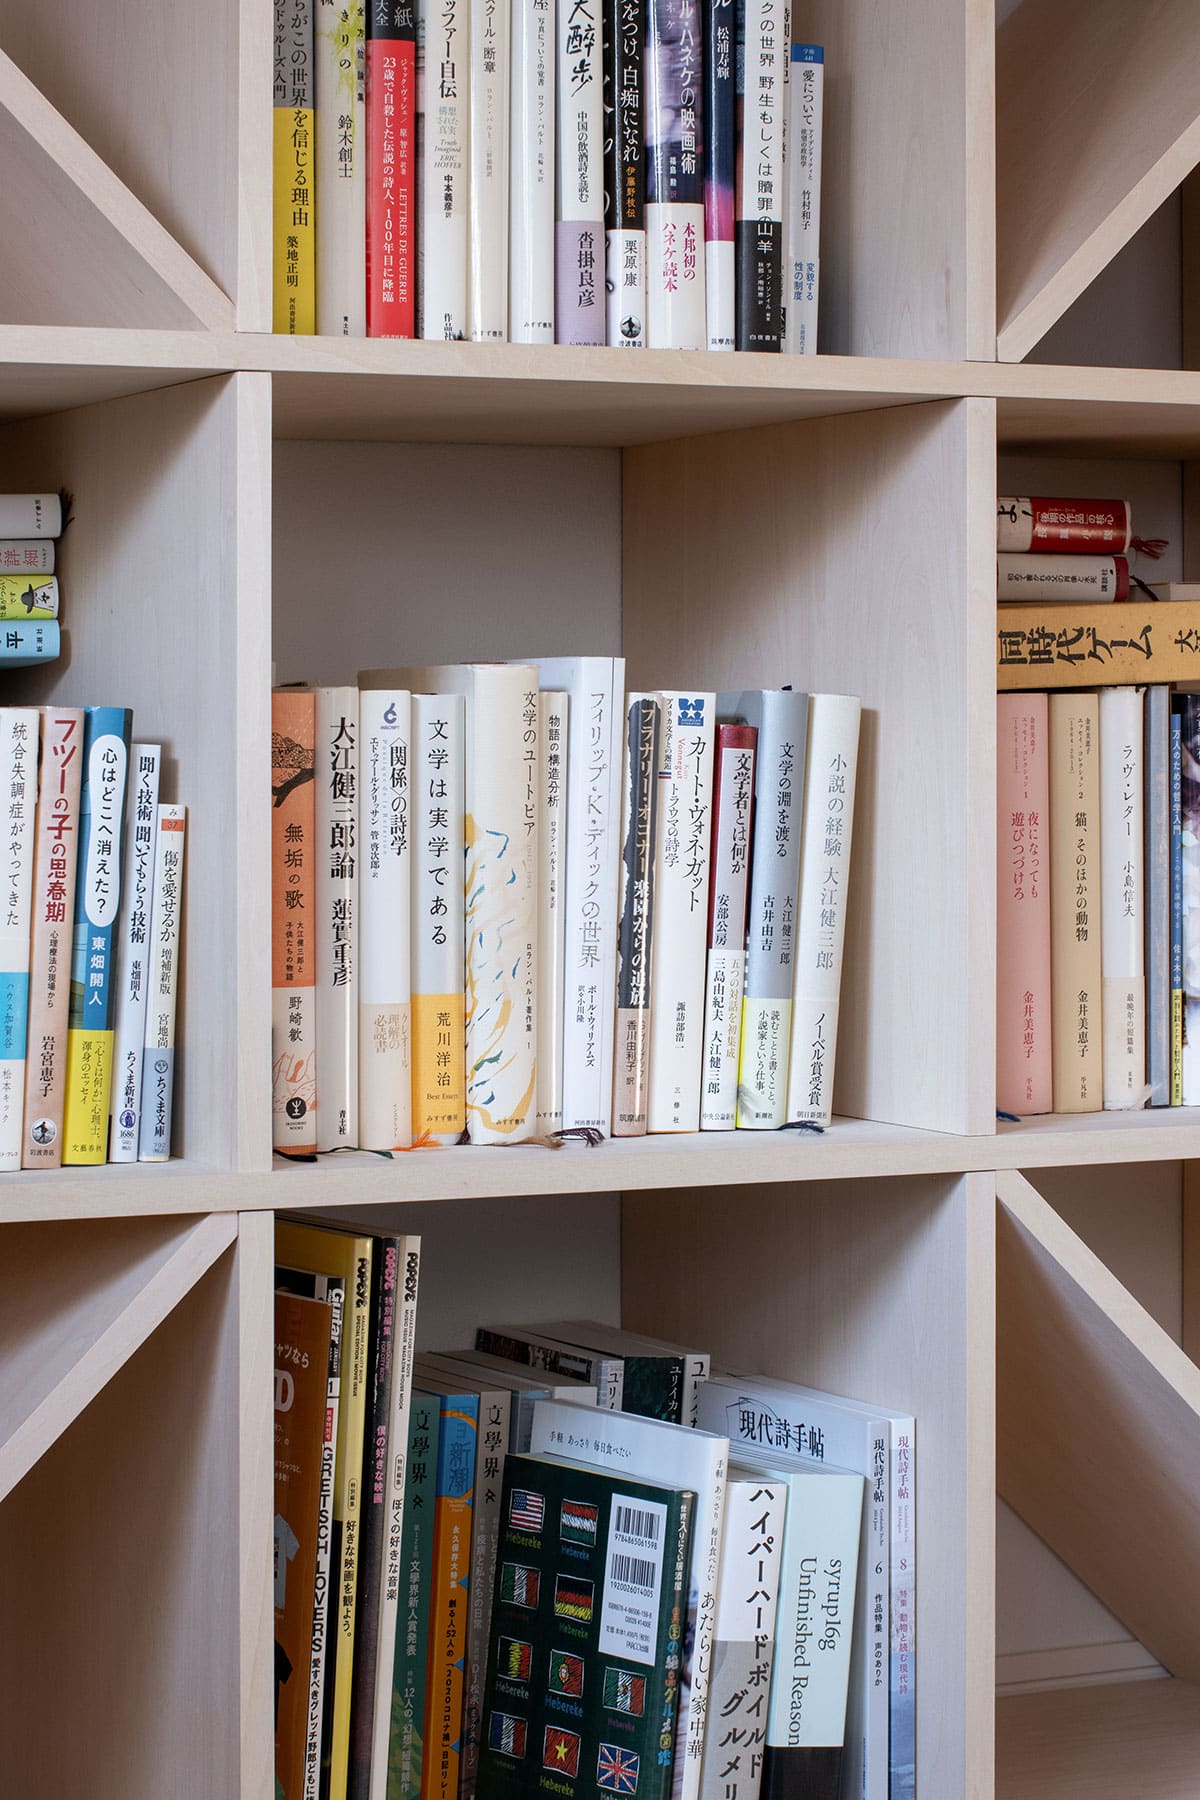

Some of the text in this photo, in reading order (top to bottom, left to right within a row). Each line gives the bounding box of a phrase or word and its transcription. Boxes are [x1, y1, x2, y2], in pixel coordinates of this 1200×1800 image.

[375, 0, 389, 26] 大全
[393, 7, 412, 29] 紙
[759, 1, 775, 68] クの世界
[620, 0, 640, 162] をつけ、白痴になれ
[680, 0, 696, 175] ル・ハネケの映画術
[717, 26, 731, 80] 松浦寿輝
[802, 69, 815, 125] 愛について
[337, 115, 353, 179] 鈴木創士
[382, 56, 397, 303] 23歳で自殺した伝説の詩人、100年目に降臨
[801, 189, 811, 231] 竹村和子
[286, 236, 298, 287] 築地正明
[399, 187, 408, 304] LETTRES DE GUERRE
[577, 231, 595, 308] 沓掛良彦
[624, 240, 638, 287] 栗原康
[663, 222, 678, 293] ハネケ読本
[683, 222, 696, 281] 本邦初の
[794, 261, 804, 301] 性の制度
[6, 631, 24, 649] 平
[998, 624, 1153, 666] 同時代ゲーム
[369, 737, 380, 826] エドゥアール・グリッサン
[522, 691, 537, 836] 文学のユートピア
[547, 714, 561, 808] 物語の構造分析
[635, 709, 655, 873] フラナリー・オコナー
[7, 722, 28, 926] 統合失調症がやってきた
[44, 720, 77, 923] フツーの子の思春期
[329, 717, 356, 880] 大江健三郎論
[389, 737, 409, 857] 〈関係〉の詩学
[427, 719, 449, 945] 文学は実学である
[577, 693, 608, 969] フィリップ・K・ディックの世界
[663, 783, 680, 868] トラウマの詩学
[682, 736, 709, 912] カート・ヴォネガット
[730, 753, 752, 875] 文学者とは何か
[775, 742, 795, 857] 文学の淵を渡る
[1122, 745, 1136, 918] ラヴ・レター 小島信夫
[131, 756, 155, 944] 聞く技術 聞いてもらう技術
[284, 823, 305, 910] 無垢の歌
[815, 753, 848, 970] 小説の経験 大江健三郎
[1010, 811, 1025, 901] 遊びつづけろ
[1028, 811, 1040, 899] 夜になっても
[1075, 811, 1088, 942] 猫、そのほかの動物
[160, 850, 179, 995] 傷を愛せるか 増補新版
[285, 921, 294, 981] 子供たちの物語
[296, 921, 305, 973] 大江健三郎と
[715, 893, 730, 946] 安部公房
[760, 895, 776, 951] 古井由吉
[779, 895, 793, 965] 大江健三郎
[88, 936, 107, 1006] 東畑開人
[130, 961, 142, 1002] 東畑開人
[288, 996, 304, 1043] 野崎歓
[436, 1011, 451, 1087] 荒川洋治
[585, 984, 597, 1068] ポール・ウィリアムズ
[625, 1020, 637, 1073] 香川由利子
[675, 1001, 687, 1049] 諏訪部浩一
[707, 957, 727, 1095] 三島由紀夫 大江健三郎
[754, 1009, 769, 1095] 小説家という仕事。
[1023, 990, 1035, 1058] 金井美恵子
[1077, 989, 1089, 1058] 金井美恵子
[39, 1035, 56, 1098] 岩宮恵子
[80, 1041, 93, 1105] 渾身のエッセイ
[125, 1050, 136, 1109] ちくま新書
[767, 1010, 781, 1106] 読むことと書くこと。
[808, 1012, 826, 1107] ノーベル賞受賞
[154, 1076, 167, 1138] ちくま文庫
[355, 1257, 369, 1309] POPEYE
[384, 1247, 396, 1291] POPEYE
[404, 1252, 418, 1303] POPEYE
[330, 1287, 345, 1345] Guitar
[667, 1365, 682, 1412] ユリイカ
[373, 1425, 386, 1505] 僕の好きな映画
[411, 1410, 431, 1484] 文學界
[448, 1441, 472, 1493] 新潮
[484, 1404, 503, 1478] 文學界
[739, 1409, 825, 1463] 現代詩手帖
[873, 1438, 885, 1503] 現代詩手帖
[897, 1435, 909, 1500] 現代詩手帖
[317, 1447, 334, 1555] GRETSCH
[386, 1499, 403, 1601] ぼくの好きな音楽
[505, 1531, 543, 1550] Hebereke
[614, 1532, 658, 1551] 9784865061598
[874, 1561, 883, 1575] 6
[899, 1558, 908, 1571] 8
[311, 1561, 327, 1653] LOVERS
[342, 1520, 357, 1637] 好きな映画を観よう。
[406, 1559, 421, 1657] 文學界新人賞発表
[610, 1580, 654, 1598] 1920026014005
[818, 1558, 842, 1651] syrup16g
[558, 1623, 590, 1640] Hebereke
[743, 1488, 775, 1779] ハイパーハードボイルド
[788, 1556, 818, 1746] Unfinished Reason
[874, 1593, 883, 1687] 作品特集 声のありか
[495, 1681, 530, 1700] Hebereke
[544, 1694, 585, 1718] Hebereke
[687, 1592, 715, 1760] あたらしい家中華
[538, 1775, 577, 1797] Hebereke
